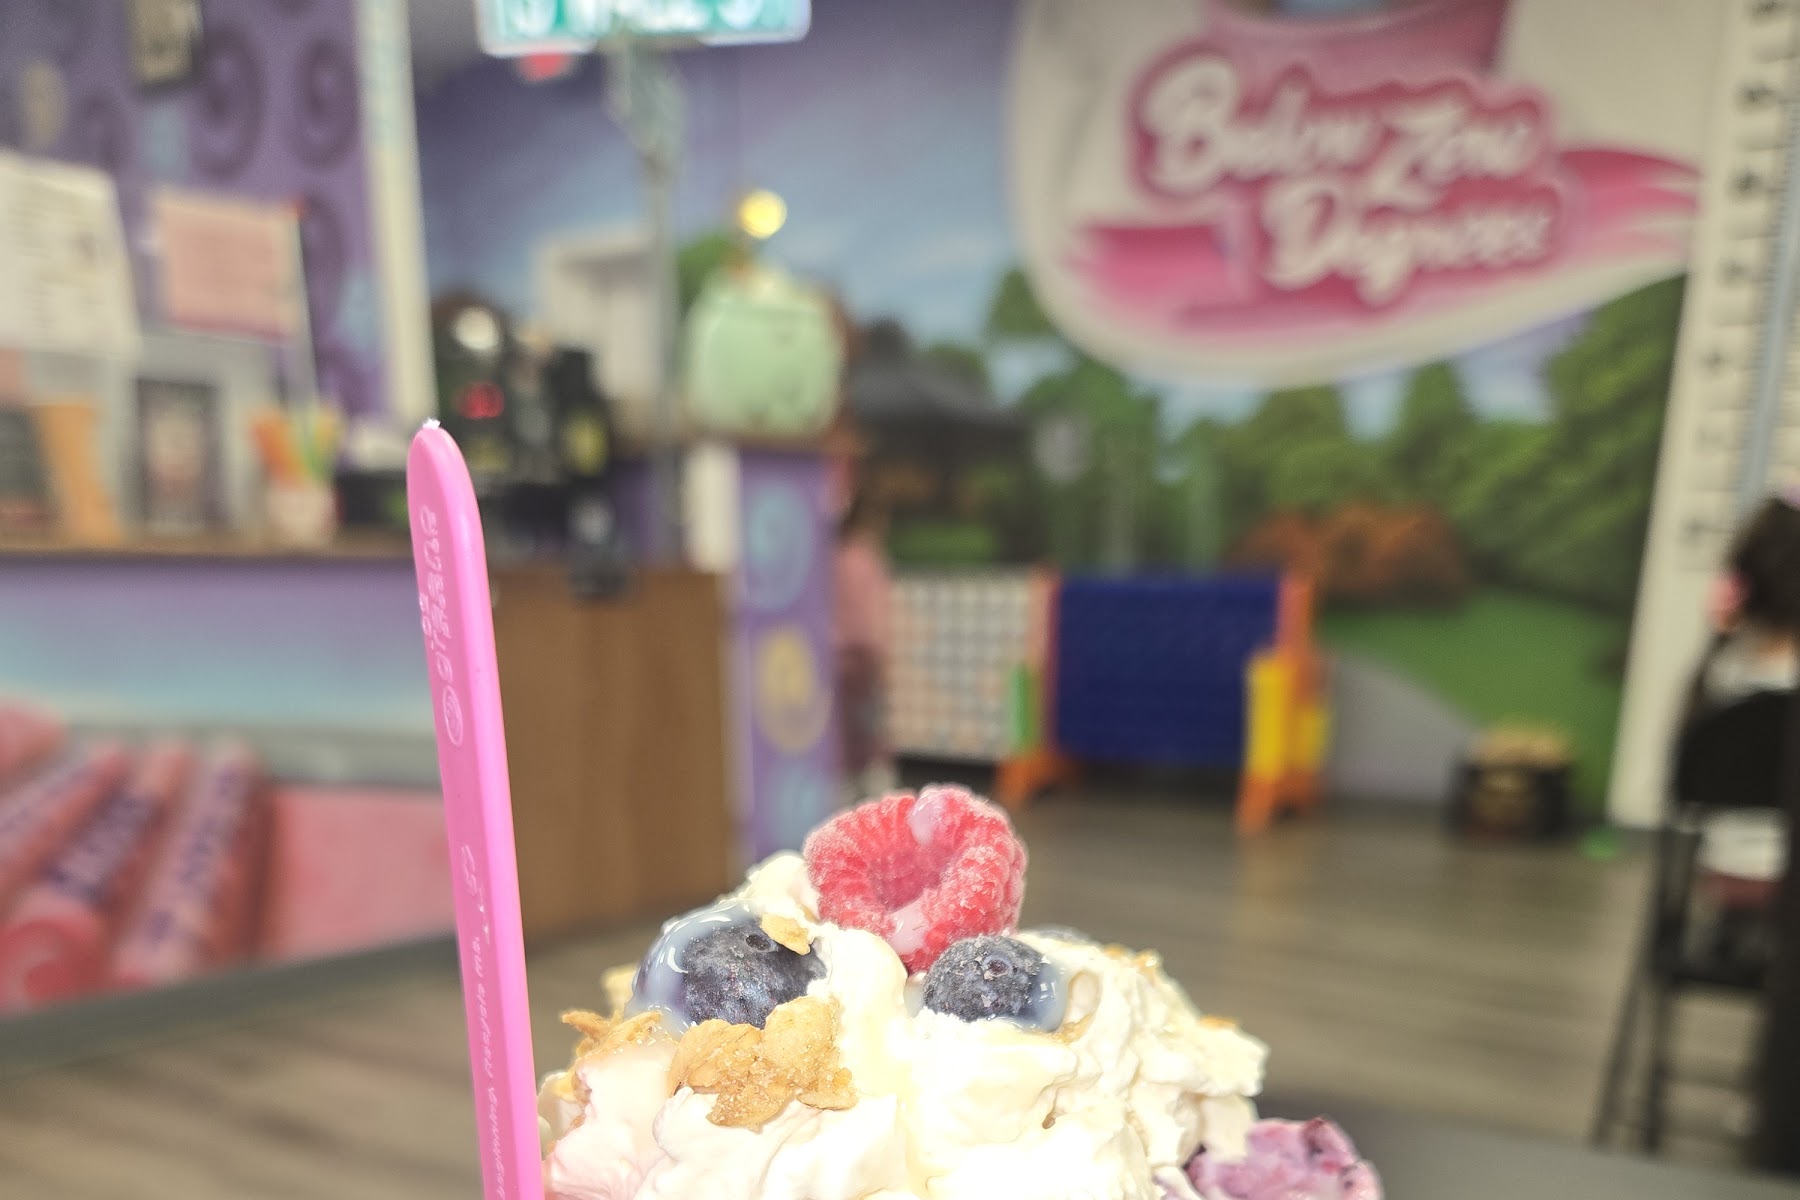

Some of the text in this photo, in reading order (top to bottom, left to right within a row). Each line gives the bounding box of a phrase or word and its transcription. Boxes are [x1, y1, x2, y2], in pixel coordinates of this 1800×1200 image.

[1142, 53, 1536, 208] Below Zero
[1259, 178, 1554, 306] Degrees
